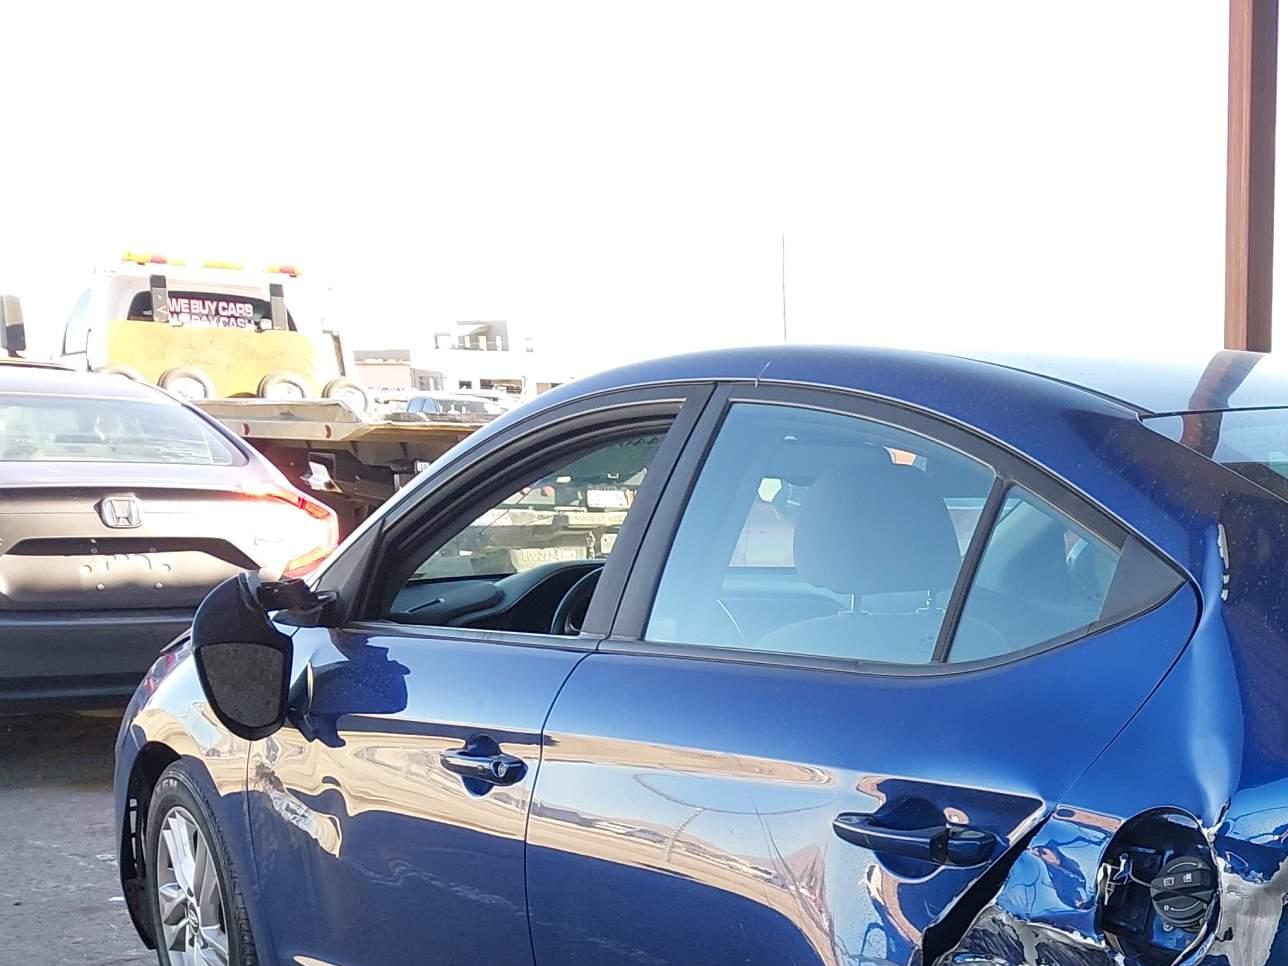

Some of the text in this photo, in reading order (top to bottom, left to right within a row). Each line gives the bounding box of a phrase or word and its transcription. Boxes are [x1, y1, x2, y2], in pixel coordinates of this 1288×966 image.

[168, 298, 254, 318] WE BUY CARS
